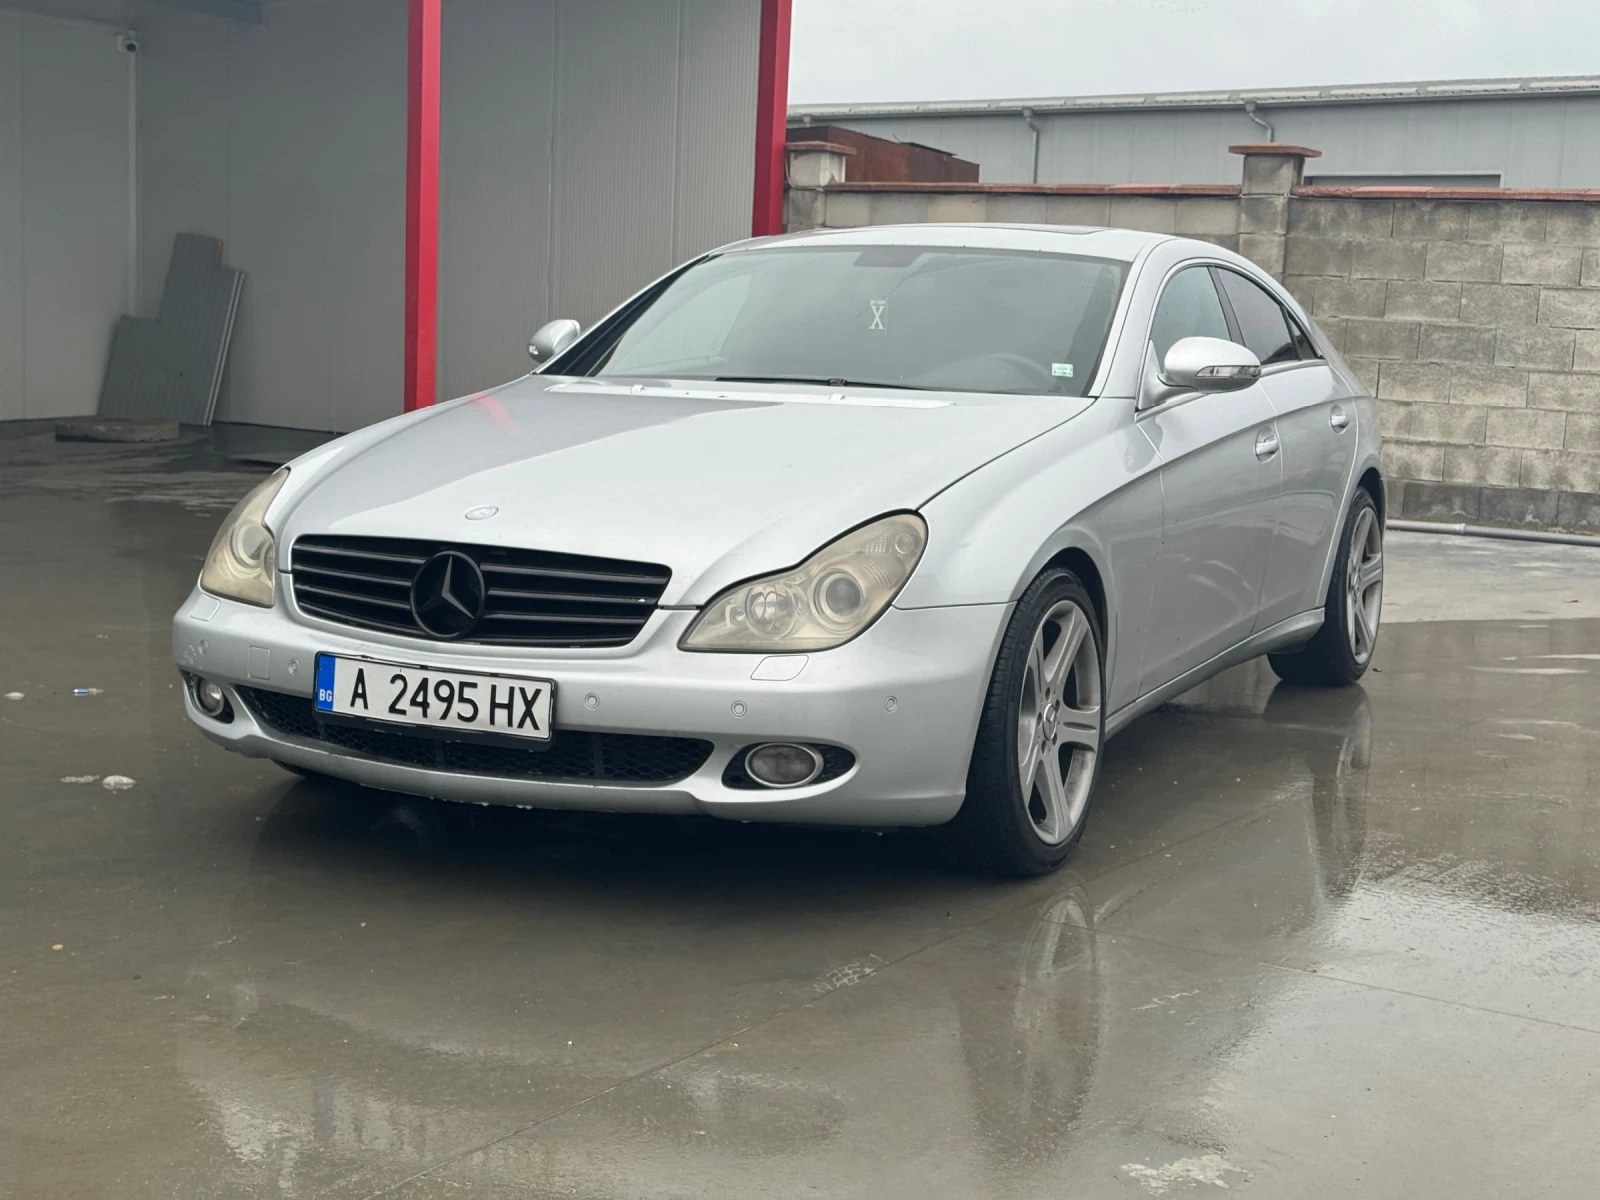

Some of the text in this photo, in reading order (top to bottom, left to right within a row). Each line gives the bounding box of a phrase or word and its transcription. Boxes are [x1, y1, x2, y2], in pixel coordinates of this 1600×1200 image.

[319, 688, 333, 703] BG
[349, 667, 542, 731] A 2495 HX
